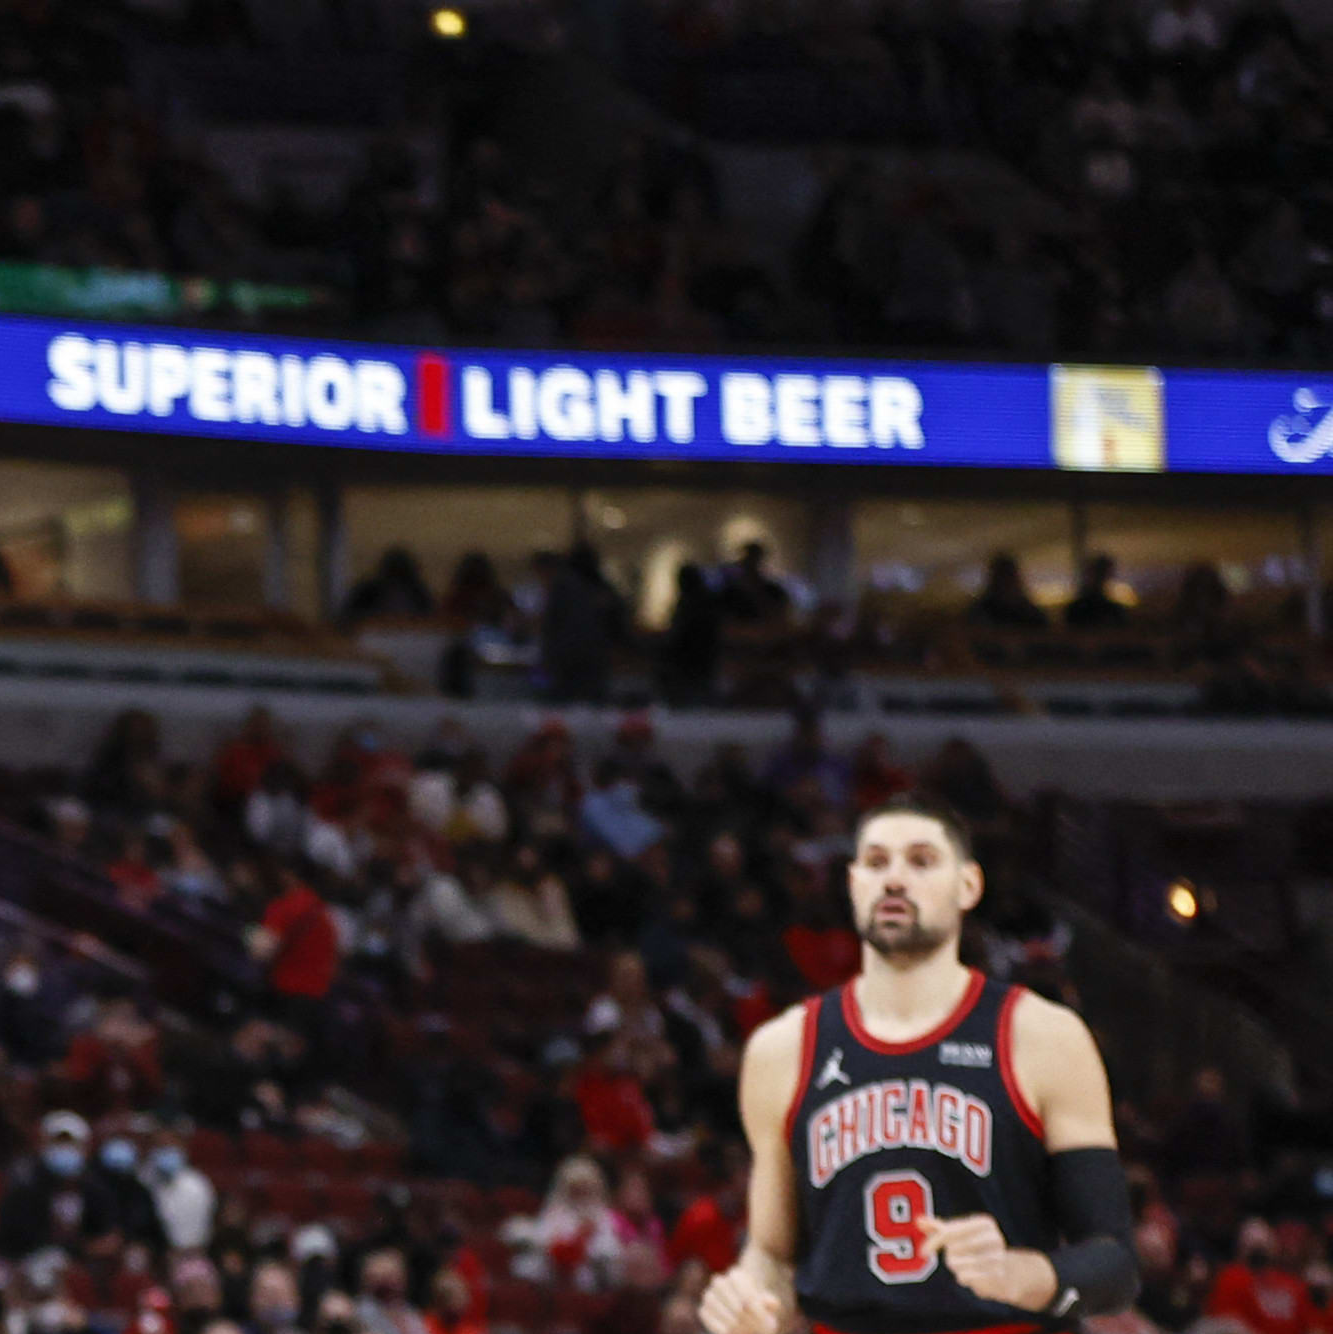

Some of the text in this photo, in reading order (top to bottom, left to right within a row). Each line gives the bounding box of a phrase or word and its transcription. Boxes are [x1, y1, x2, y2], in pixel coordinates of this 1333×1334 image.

[48, 333, 925, 449] SUPERIOR LIGHT BEER
[807, 1079, 993, 1189] CHICAGO
[864, 1169, 938, 1285] 9
